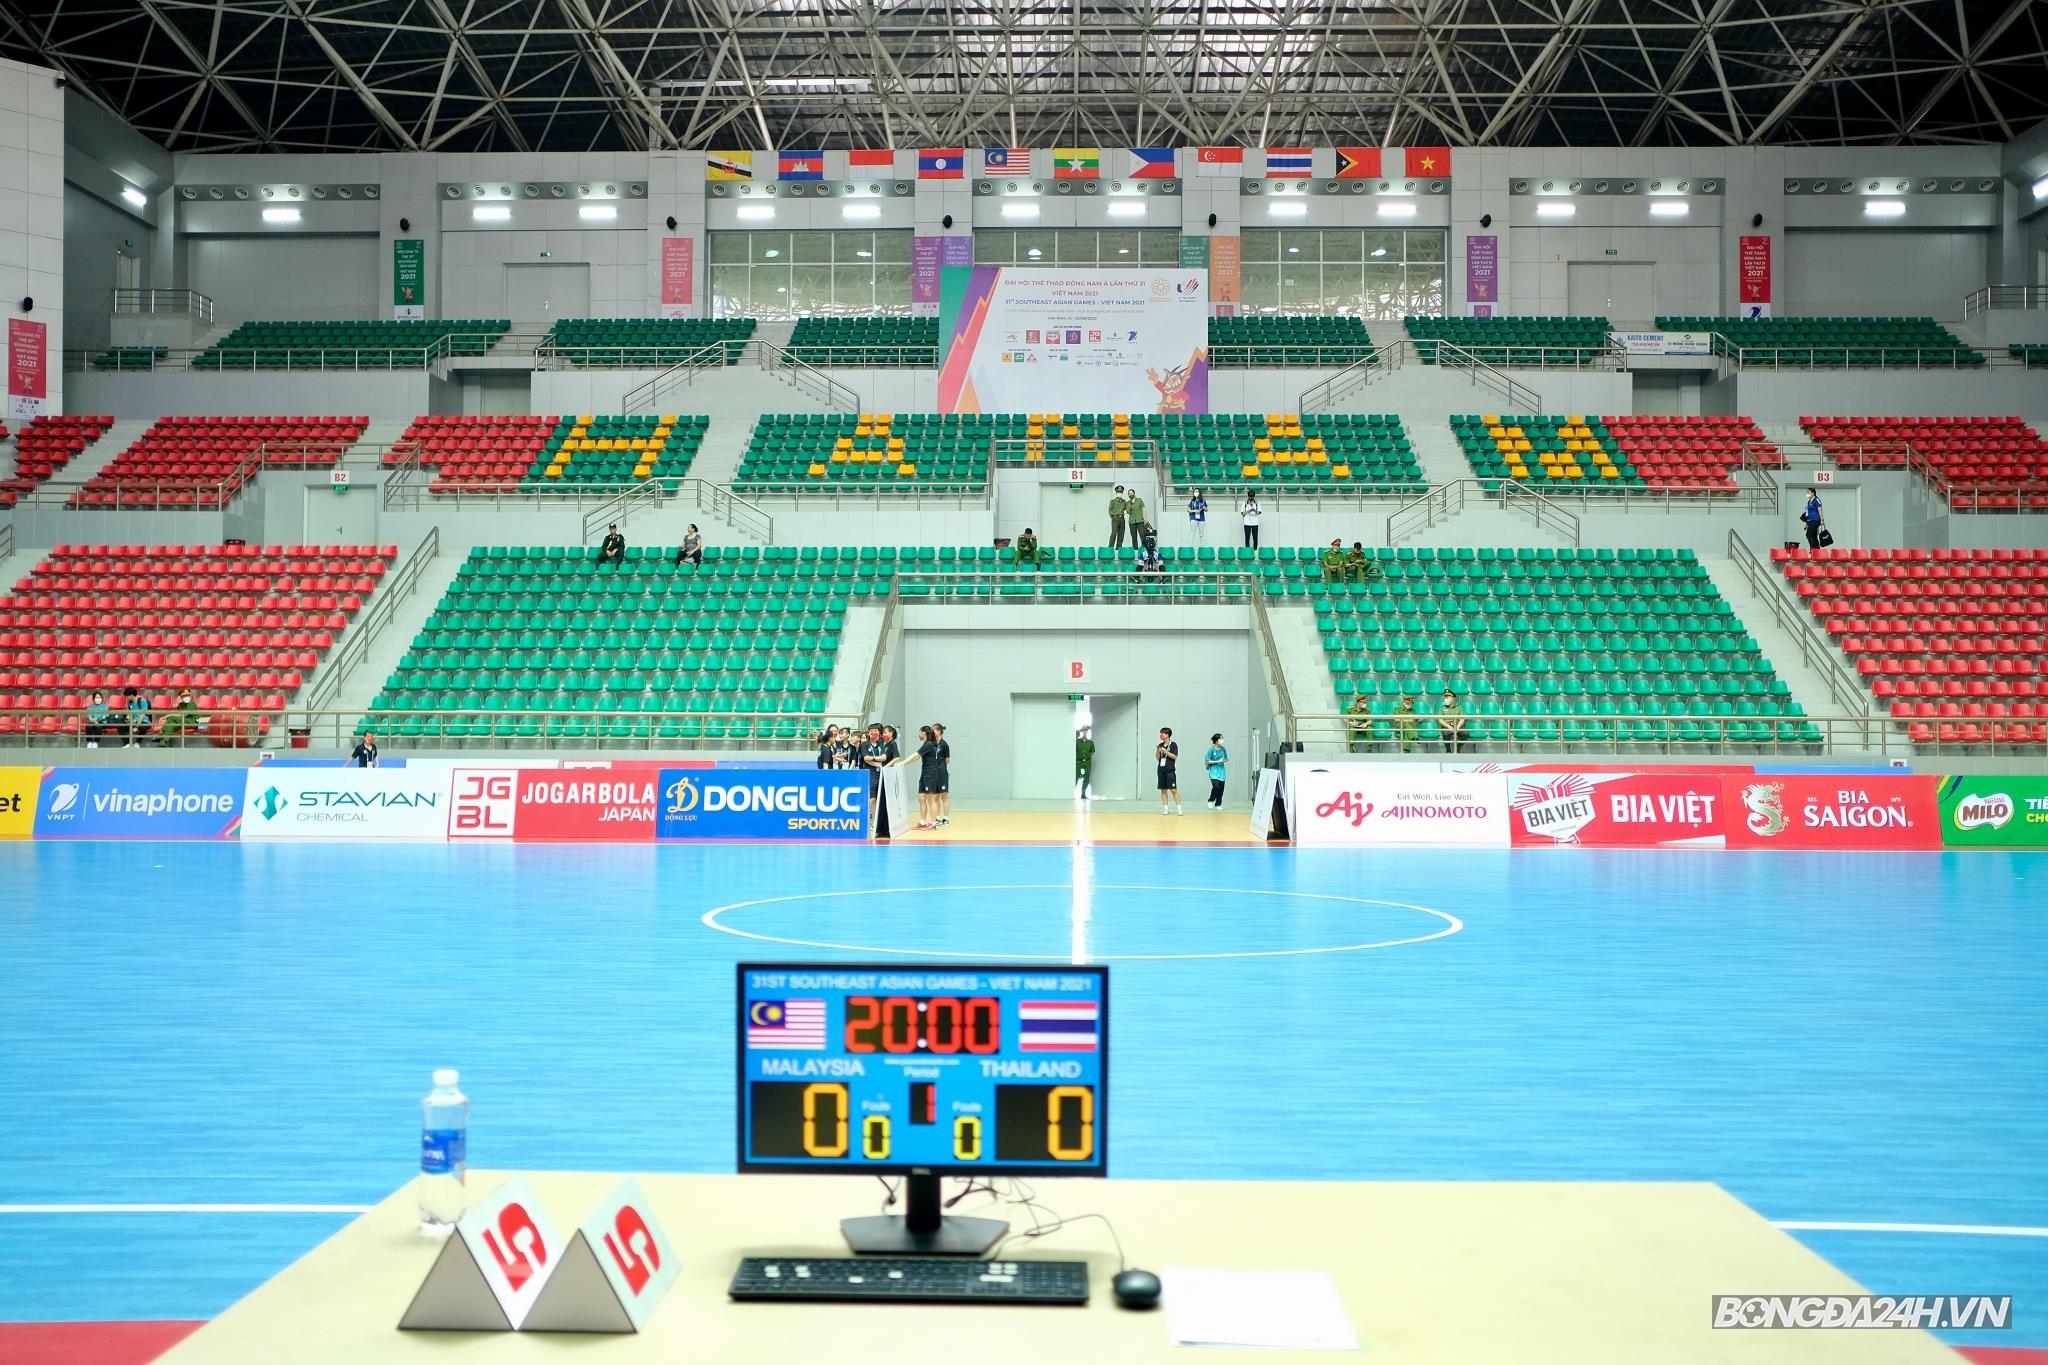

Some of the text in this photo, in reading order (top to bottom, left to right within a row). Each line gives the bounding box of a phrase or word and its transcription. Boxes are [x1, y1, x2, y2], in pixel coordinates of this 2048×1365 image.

[1072, 471, 1083, 479] B1
[1817, 473, 1829, 481] B3
[1072, 662, 1083, 678] B
[459, 776, 511, 800] JG
[522, 782, 655, 804] JOGARBOLA
[704, 785, 861, 812] DONGLUC
[1838, 791, 1870, 804] BIA
[94, 788, 234, 816] vinaphone
[299, 792, 435, 807] STAVIAN
[1316, 792, 1374, 826] Aj
[1610, 790, 1715, 828] BIA VIỆT
[297, 812, 368, 821] CHEMICAL
[456, 805, 507, 828] BL
[598, 807, 655, 821] JAPAN
[1381, 806, 1487, 820] AJINOMOTO
[1527, 799, 1588, 827] BIA VIỆT
[1804, 805, 1907, 827] SAIGON
[1963, 804, 2008, 821] MILO
[788, 817, 860, 831] SPORT.VN
[752, 976, 785, 989] 31ST
[789, 976, 876, 989] SOUTHEAST
[878, 976, 924, 989] ASIAN
[926, 976, 979, 990] GAMES
[989, 976, 1022, 990] VIET
[1025, 976, 1056, 990] NAM
[1059, 977, 1092, 990] 2021
[846, 996, 999, 1054] 20:00
[762, 1058, 864, 1076] MALAYSIA
[980, 1060, 1082, 1079] THAILAND
[927, 1084, 935, 1123] 1
[803, 1082, 848, 1157] 0
[1048, 1086, 1093, 1160] 0
[863, 1115, 890, 1159] 0
[954, 1116, 981, 1160] 0
